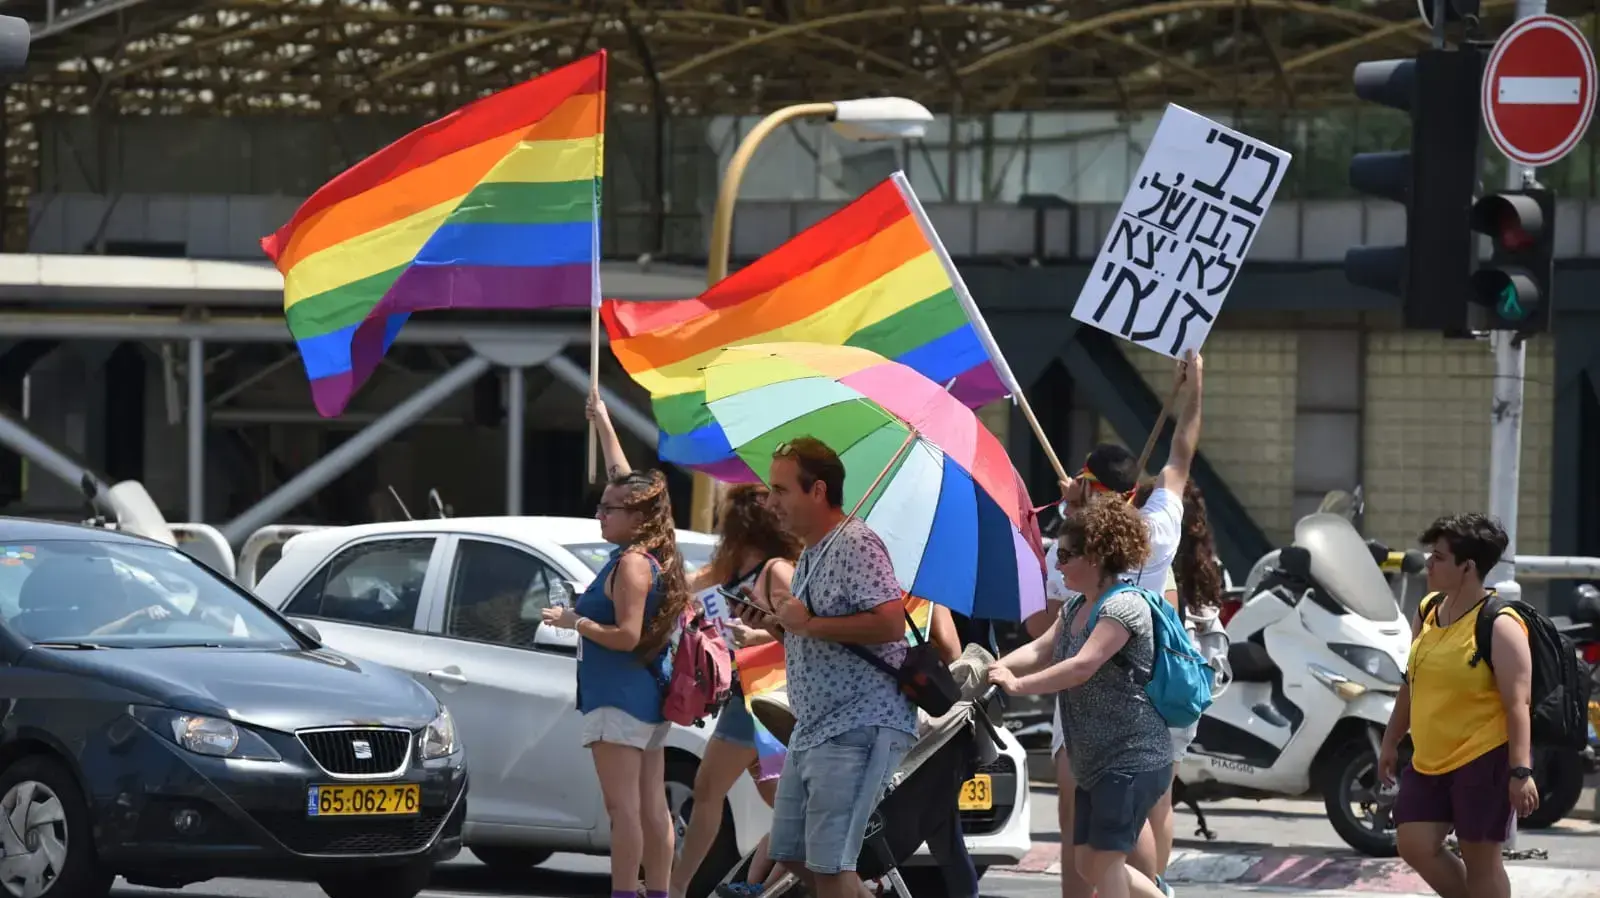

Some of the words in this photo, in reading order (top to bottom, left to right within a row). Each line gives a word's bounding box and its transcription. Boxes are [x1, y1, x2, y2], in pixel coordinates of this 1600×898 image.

[1137, 172, 1198, 232] שלי
[1184, 202, 1256, 259] הבן
[1176, 247, 1237, 297] לא
[1211, 759, 1254, 775] PIAGGIO
